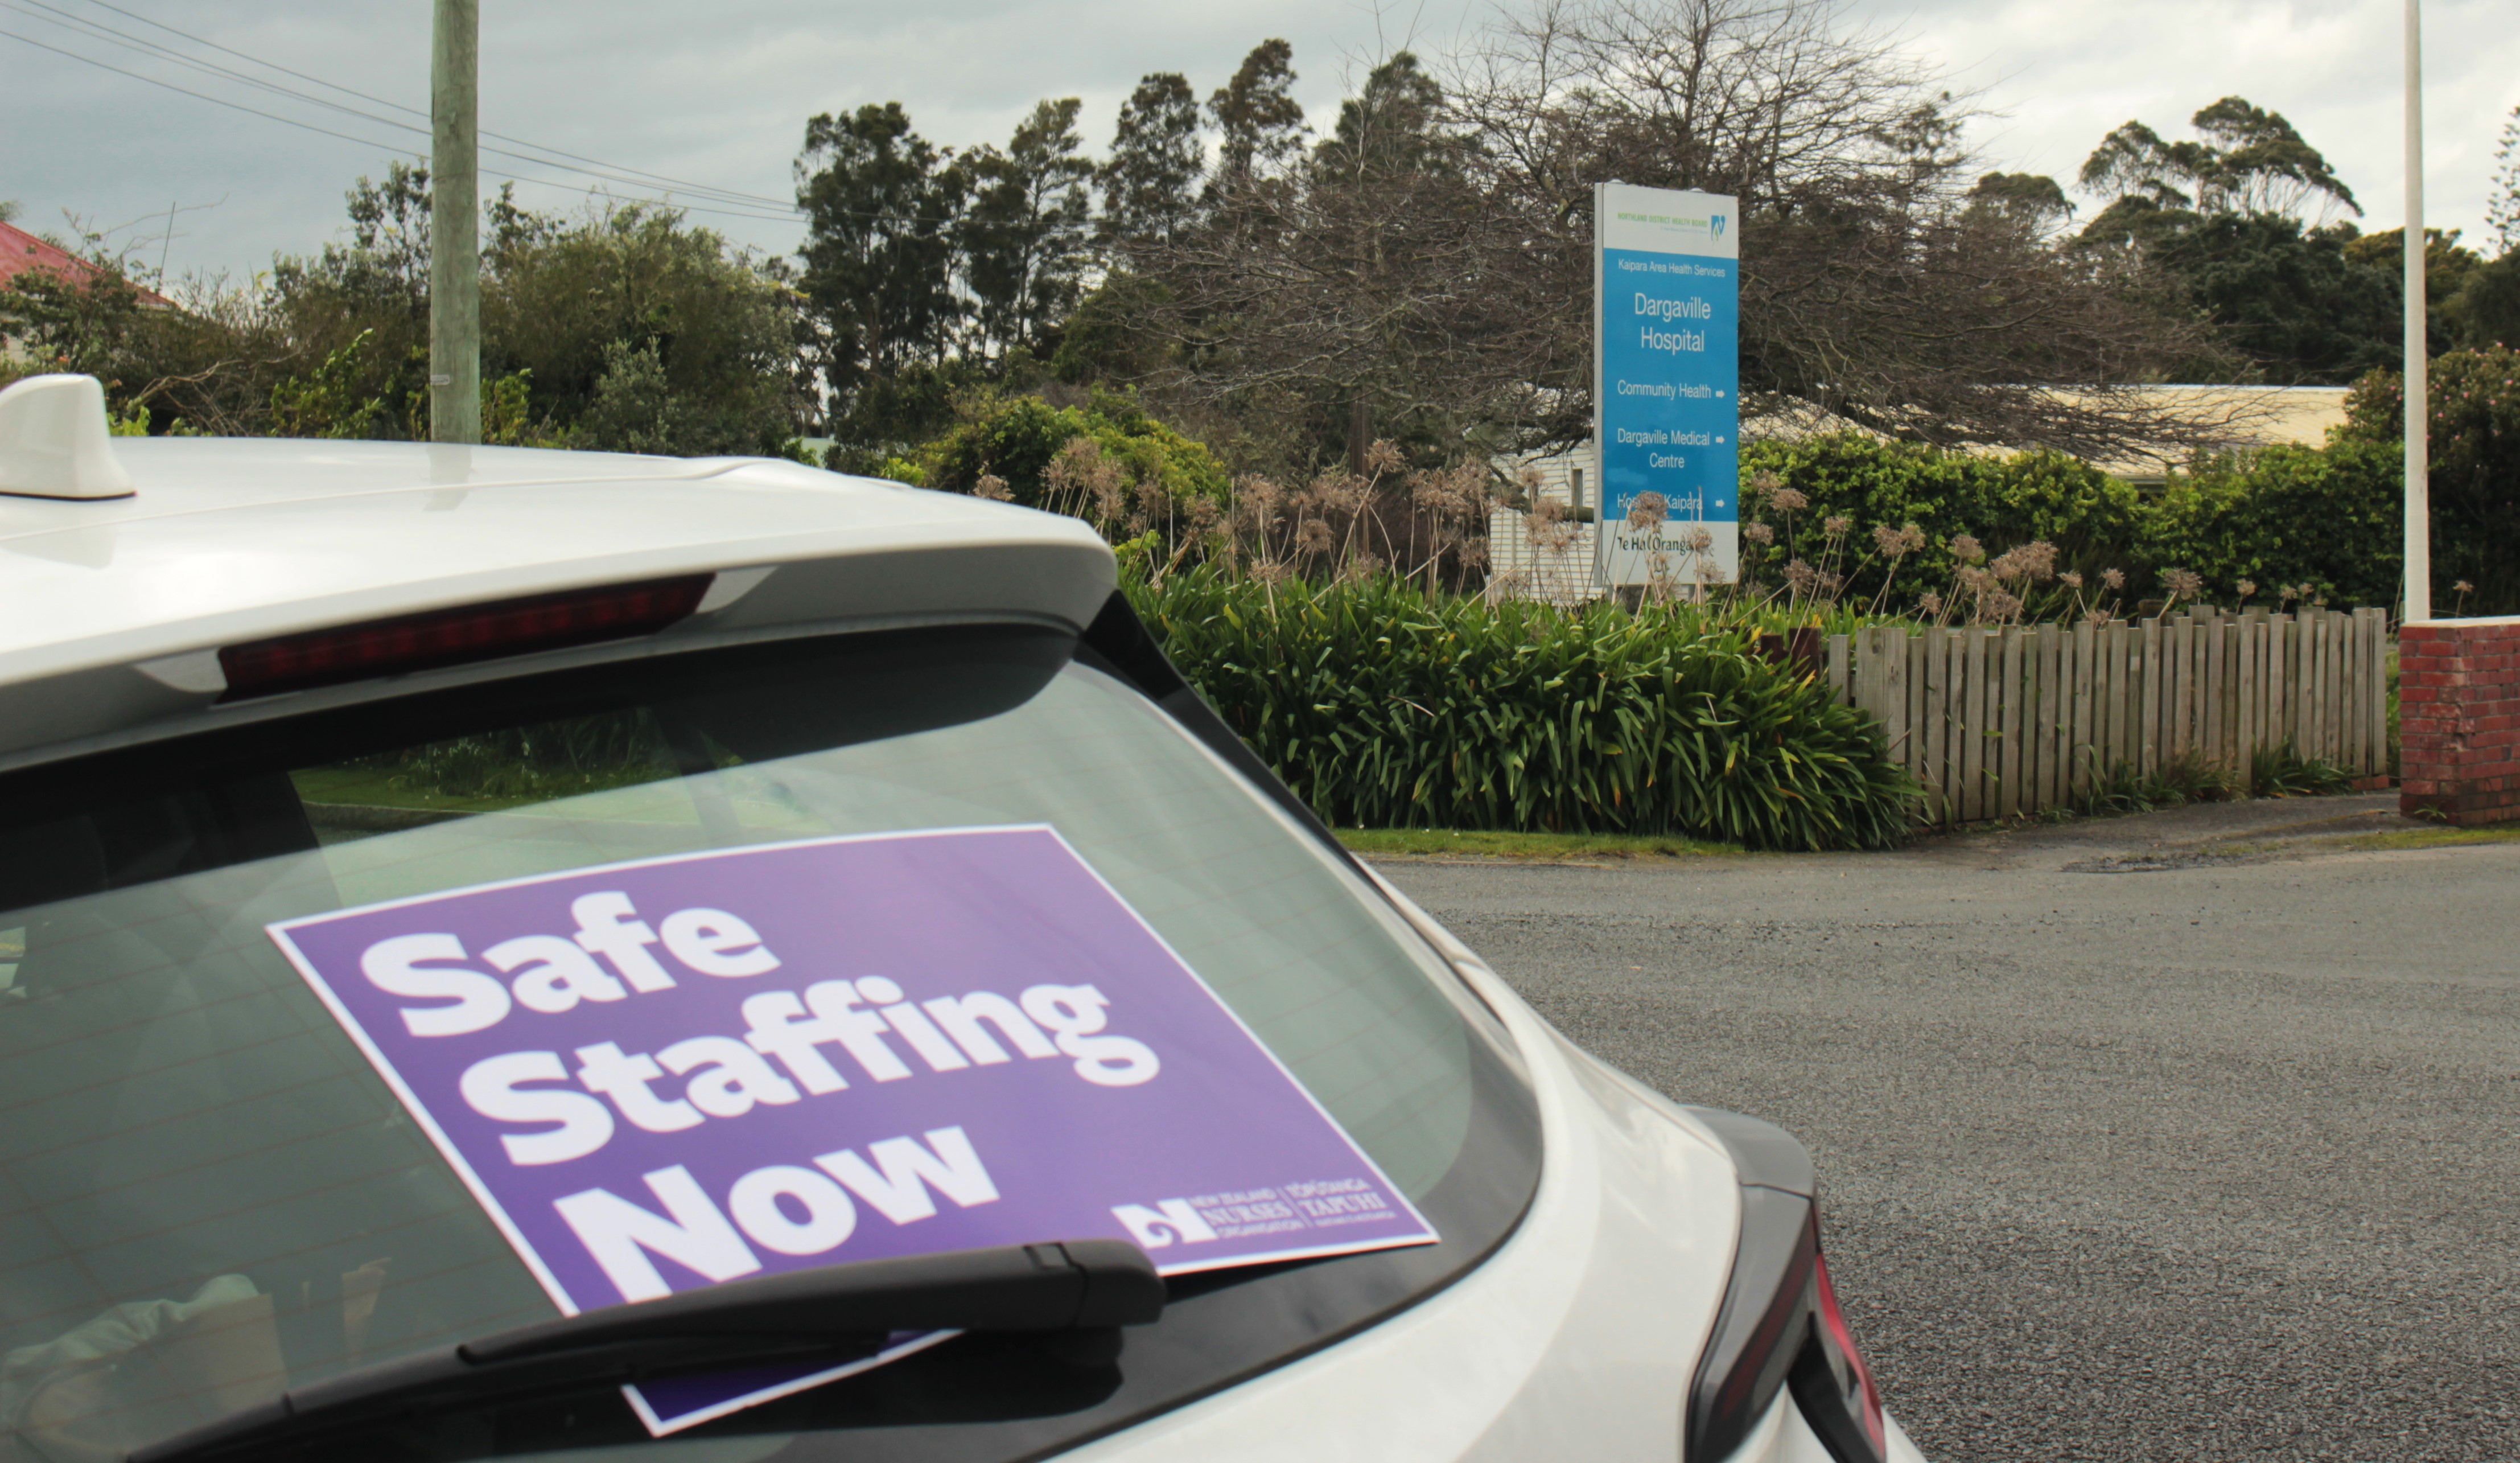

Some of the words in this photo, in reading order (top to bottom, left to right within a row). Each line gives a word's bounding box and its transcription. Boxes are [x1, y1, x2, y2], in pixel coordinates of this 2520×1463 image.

[1617, 212, 1648, 222] NORTHLAND
[1649, 215, 1671, 224] DISTRICT
[1672, 217, 1691, 226] HEALTH
[1692, 219, 1708, 228] BOARD
[1618, 259, 1648, 272] Kaipara
[1649, 261, 1666, 273] Area
[1669, 263, 1693, 275] Health
[1694, 265, 1726, 278] Services
[1635, 293, 1711, 323] Dargaville
[1641, 326, 1704, 355] Hospital
[1617, 380, 1675, 400] Community
[1679, 383, 1711, 398] Health
[1617, 428, 1668, 447] Dargaville
[1670, 430, 1710, 446] Medical
[1650, 453, 1685, 469] Centre
[1664, 494, 1703, 512] Kaipara
[1617, 537, 1629, 550] Te
[361, 891, 780, 1037] Safe
[459, 976, 1161, 1167] Staffing
[552, 1126, 1000, 1304] Now
[1201, 1201, 1294, 1226] NURSES
[1298, 1191, 1388, 1217] TAPUHI
